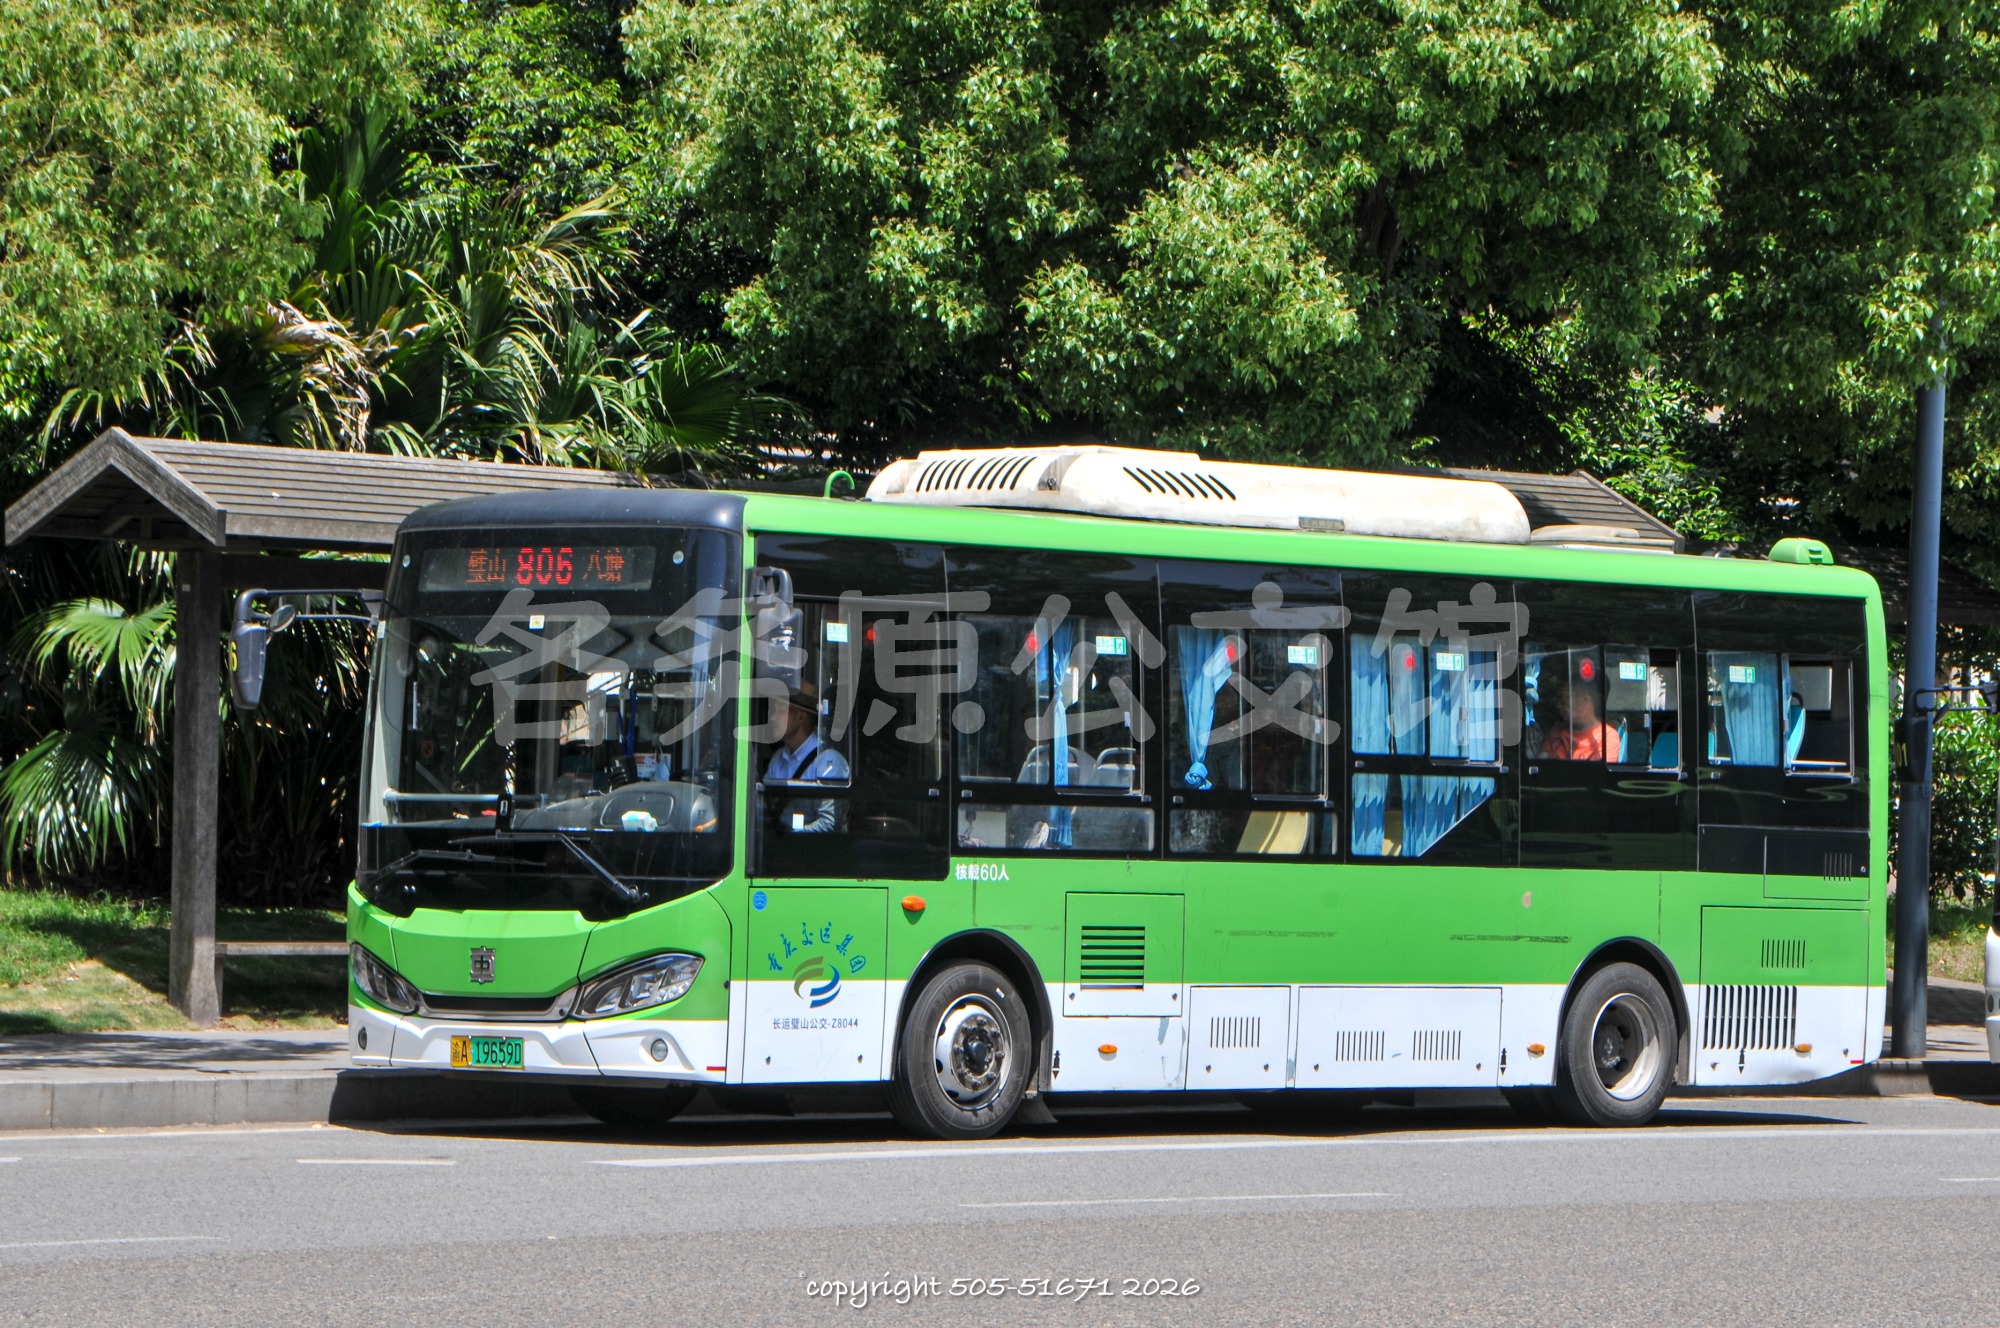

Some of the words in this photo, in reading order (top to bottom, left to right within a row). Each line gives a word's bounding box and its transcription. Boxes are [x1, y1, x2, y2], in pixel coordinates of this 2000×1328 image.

[466, 548, 507, 583] 璧山
[516, 547, 573, 585] 806
[955, 863, 1010, 881] 核载60人
